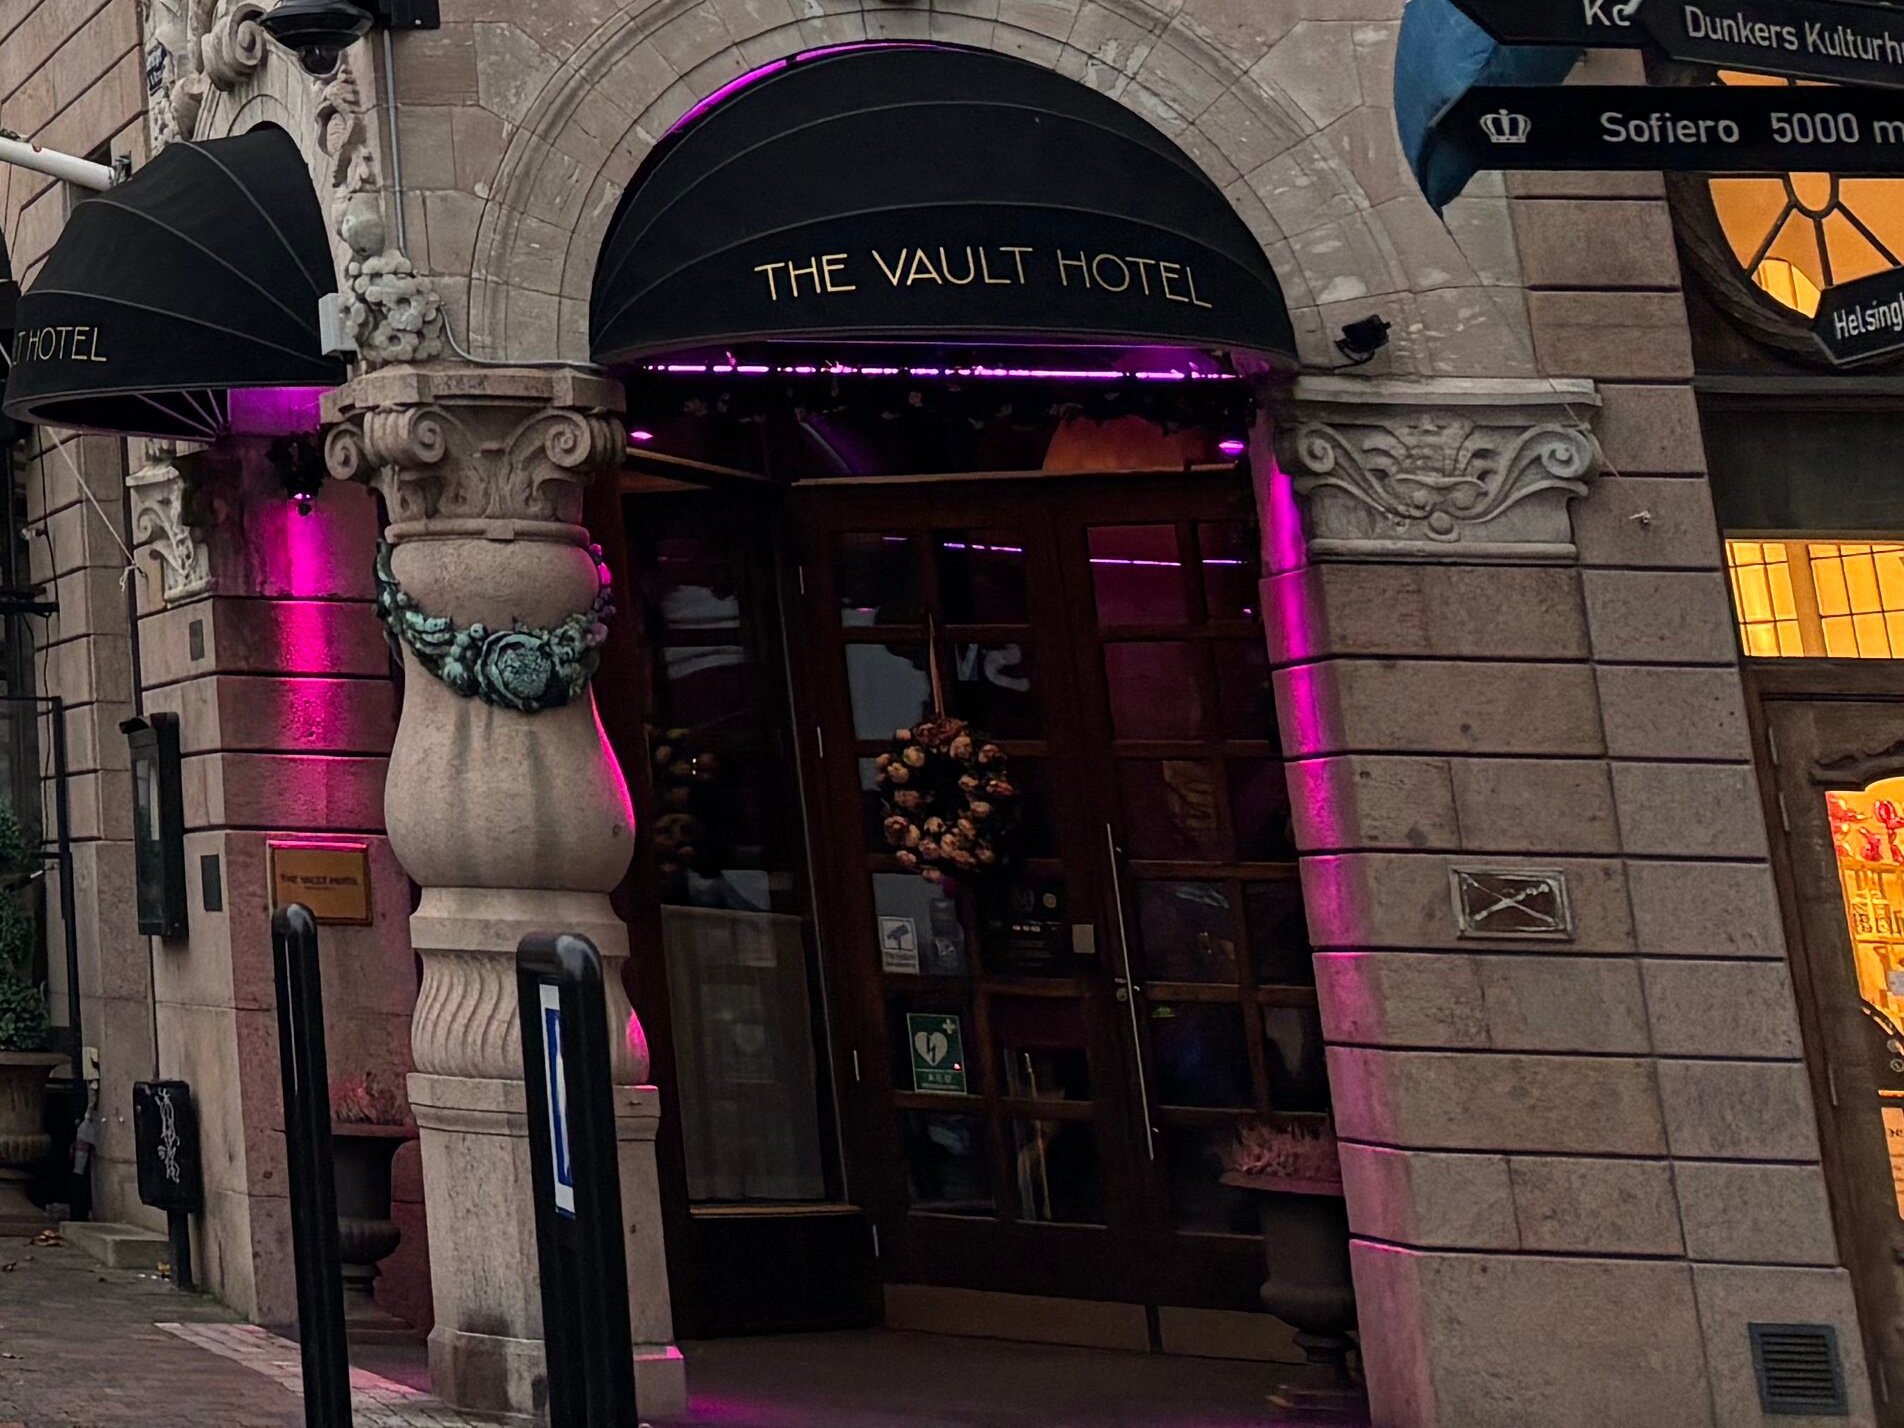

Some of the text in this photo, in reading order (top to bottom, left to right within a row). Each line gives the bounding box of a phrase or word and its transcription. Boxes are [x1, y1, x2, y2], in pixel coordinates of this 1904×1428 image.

[1685, 5, 1798, 51] Dunkers
[1804, 21, 1904, 64] Kulturh
[1600, 111, 1904, 144] Sofiero 5000 m
[754, 246, 1213, 309] THE VAULT HOTEL
[1834, 291, 1904, 340] Helsing
[26, 326, 107, 362] HOTEL
